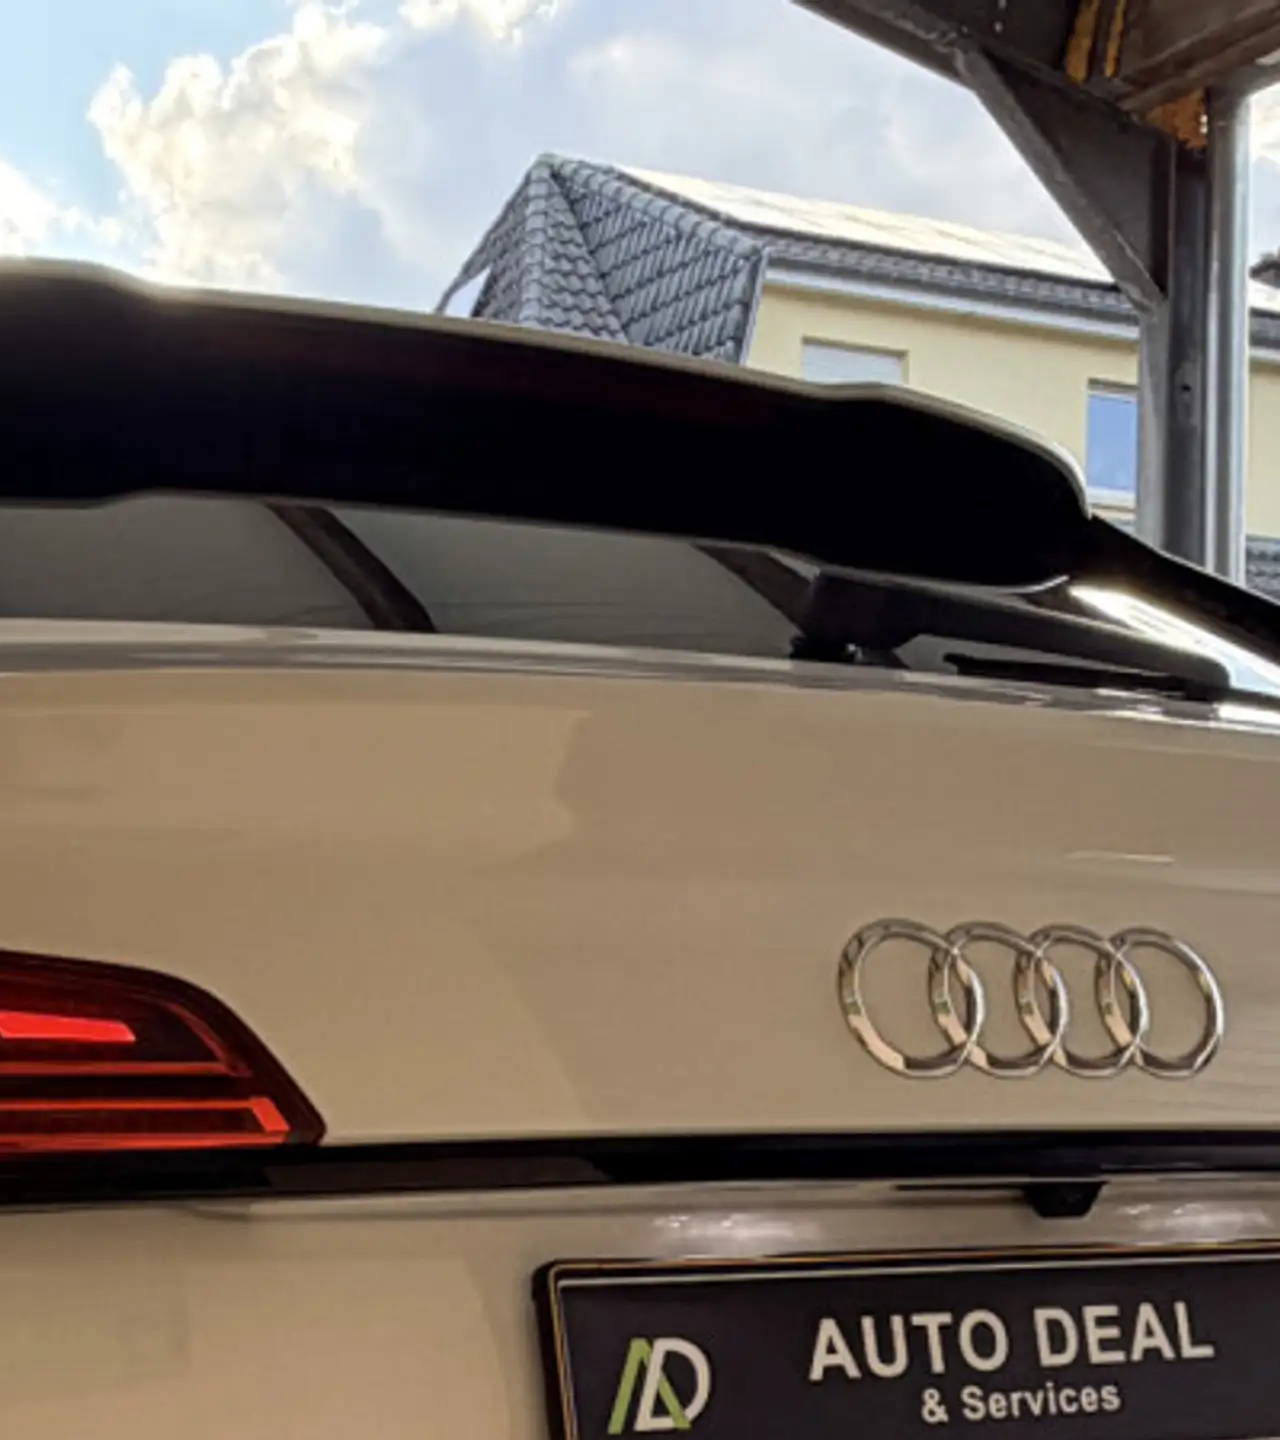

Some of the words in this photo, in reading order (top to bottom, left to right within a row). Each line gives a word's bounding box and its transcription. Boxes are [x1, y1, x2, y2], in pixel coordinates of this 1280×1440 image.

[808, 1308, 1009, 1382] AUTO
[1033, 1301, 1216, 1368] DEAL
[921, 1387, 949, 1424] &
[960, 1382, 1121, 1421] Services
